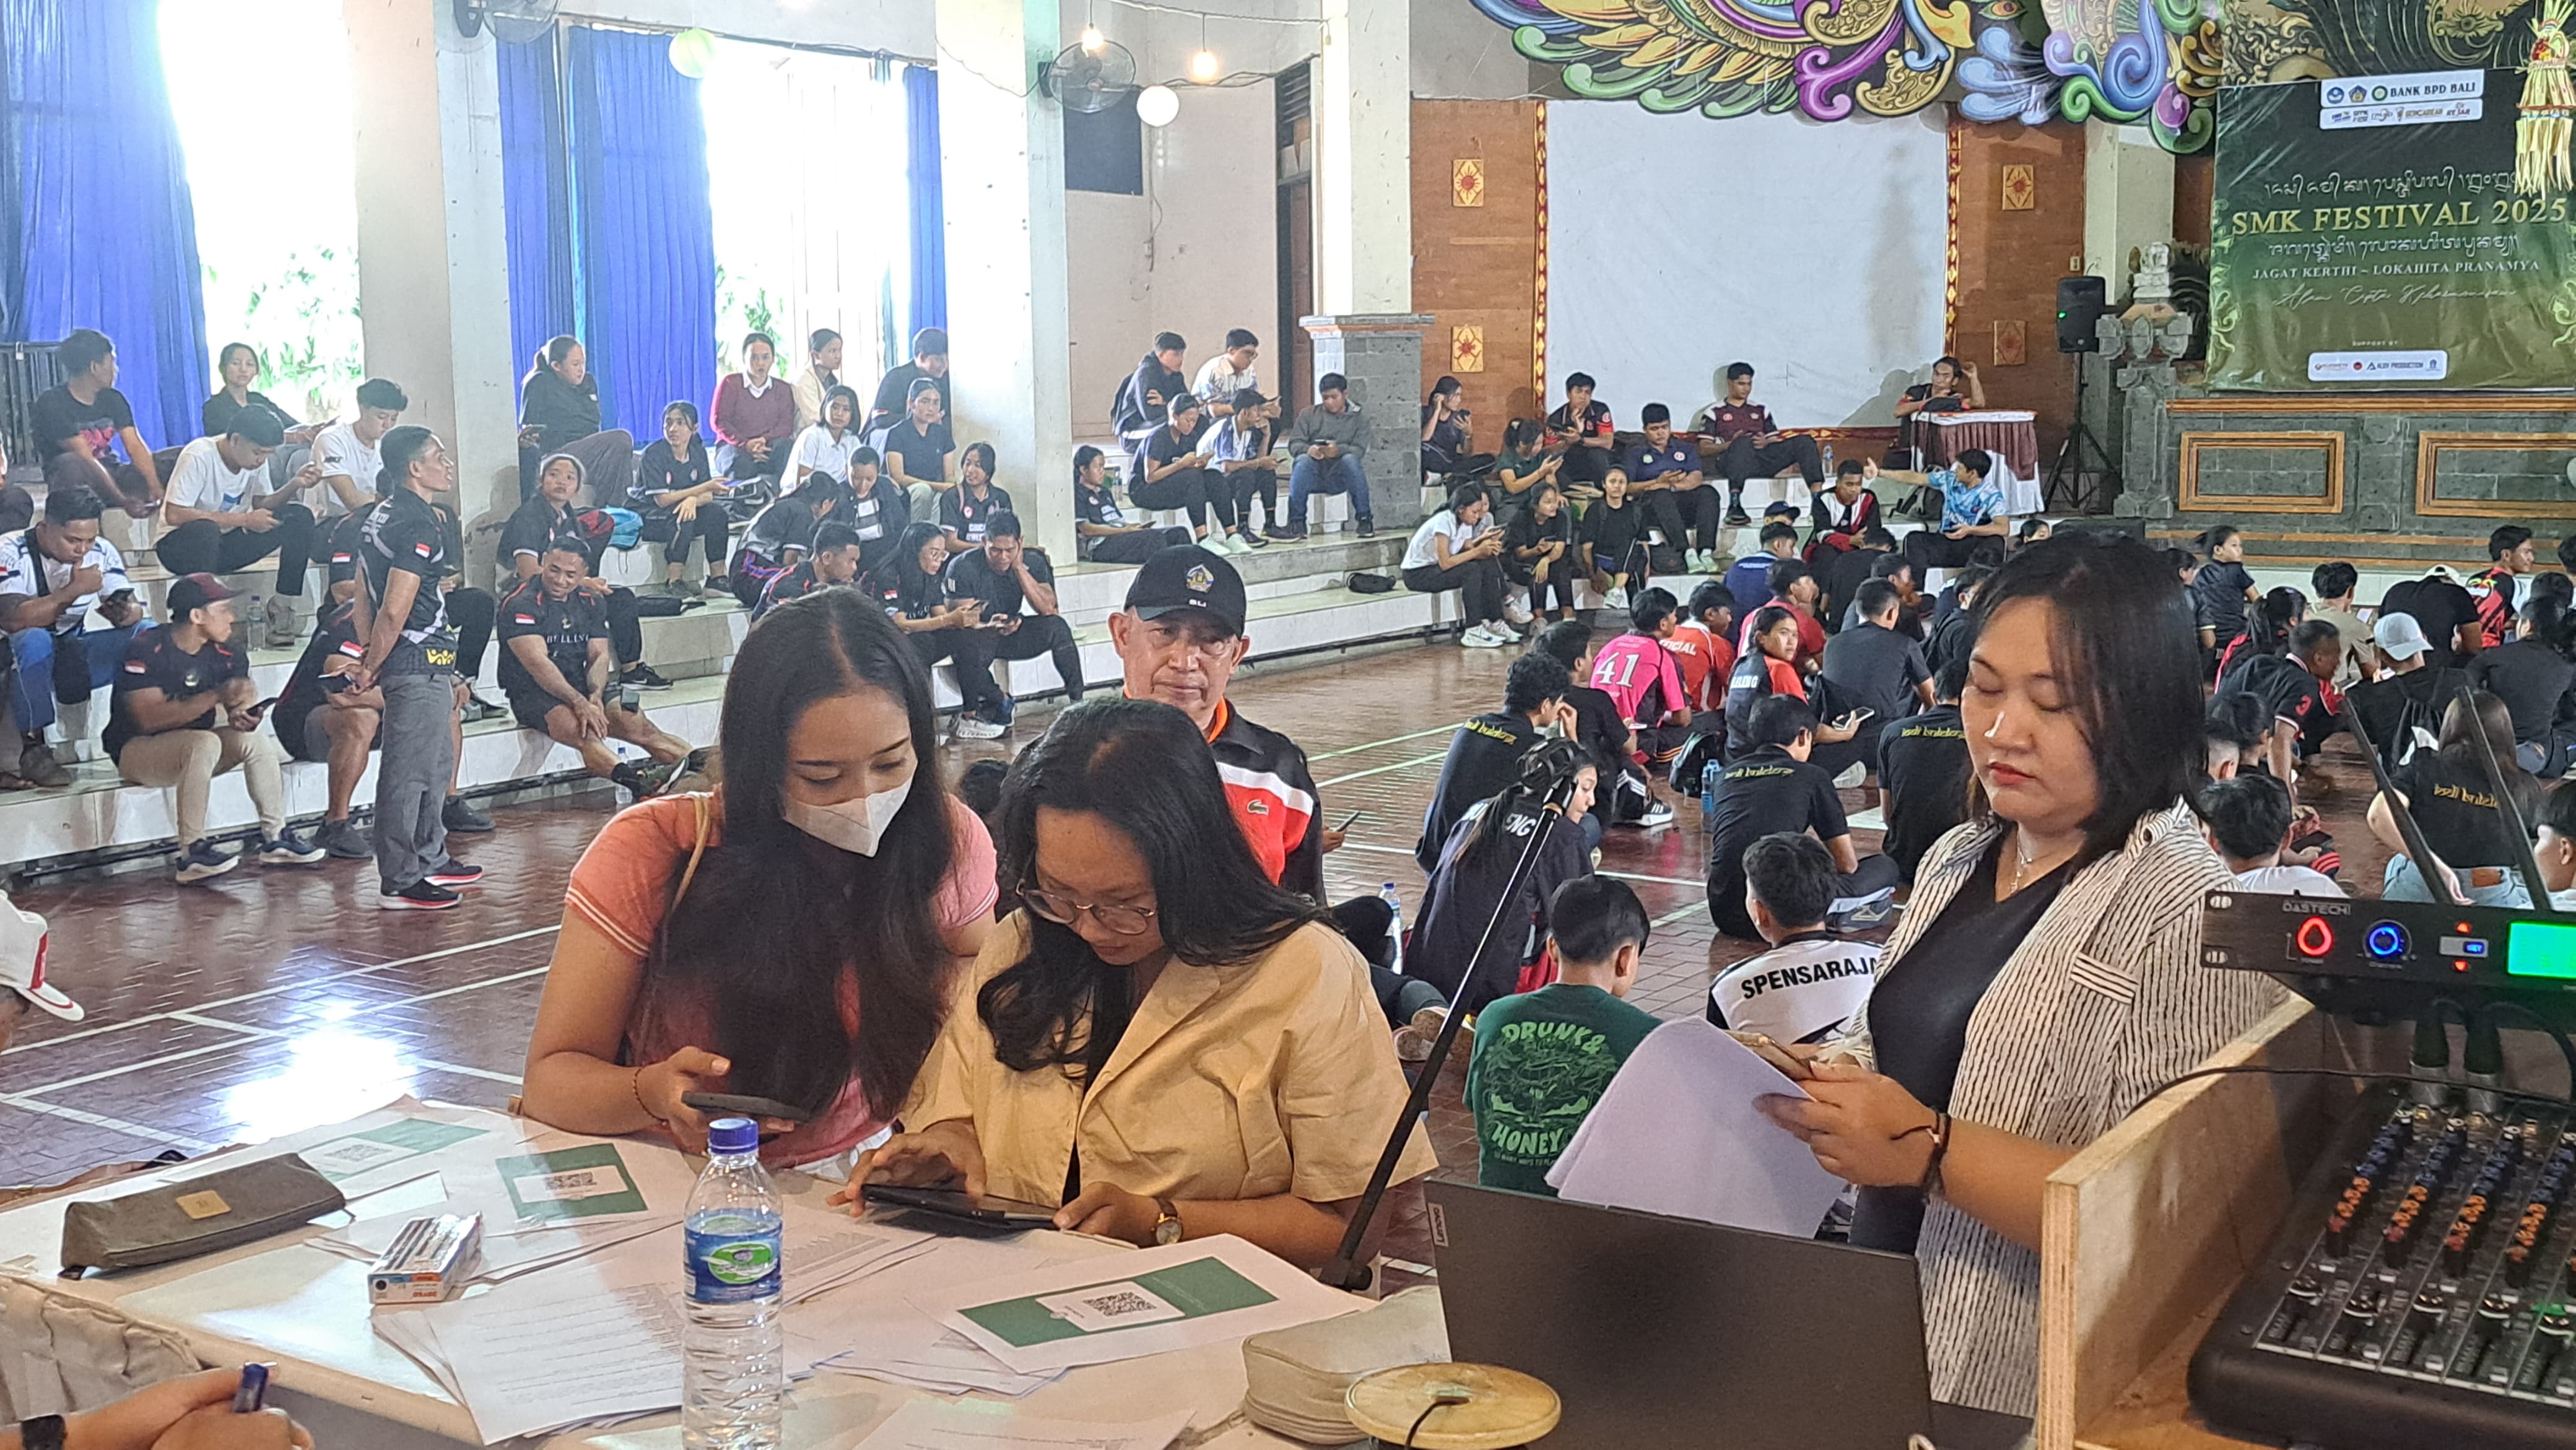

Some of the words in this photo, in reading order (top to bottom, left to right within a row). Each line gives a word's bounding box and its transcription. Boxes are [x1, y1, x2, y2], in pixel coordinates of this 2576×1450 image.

[2390, 87, 2420, 97] BANK
[2424, 84, 2447, 95] BPD
[2450, 82, 2476, 93] BALI
[2232, 210, 2302, 237] SMK
[2313, 201, 2480, 232] FESTIVAL
[2491, 198, 2567, 225] 2025
[2253, 267, 2299, 280] JAGAT
[2302, 266, 2357, 279] KERTHI
[2373, 264, 2450, 276] LOKAHITA
[2455, 260, 2540, 274] PRANAMYA
[1596, 651, 1640, 688] 41
[1581, 1035, 1606, 1054] &
[1491, 1122, 1565, 1155] HONEY
[1432, 1207, 1445, 1243] Lenovo
